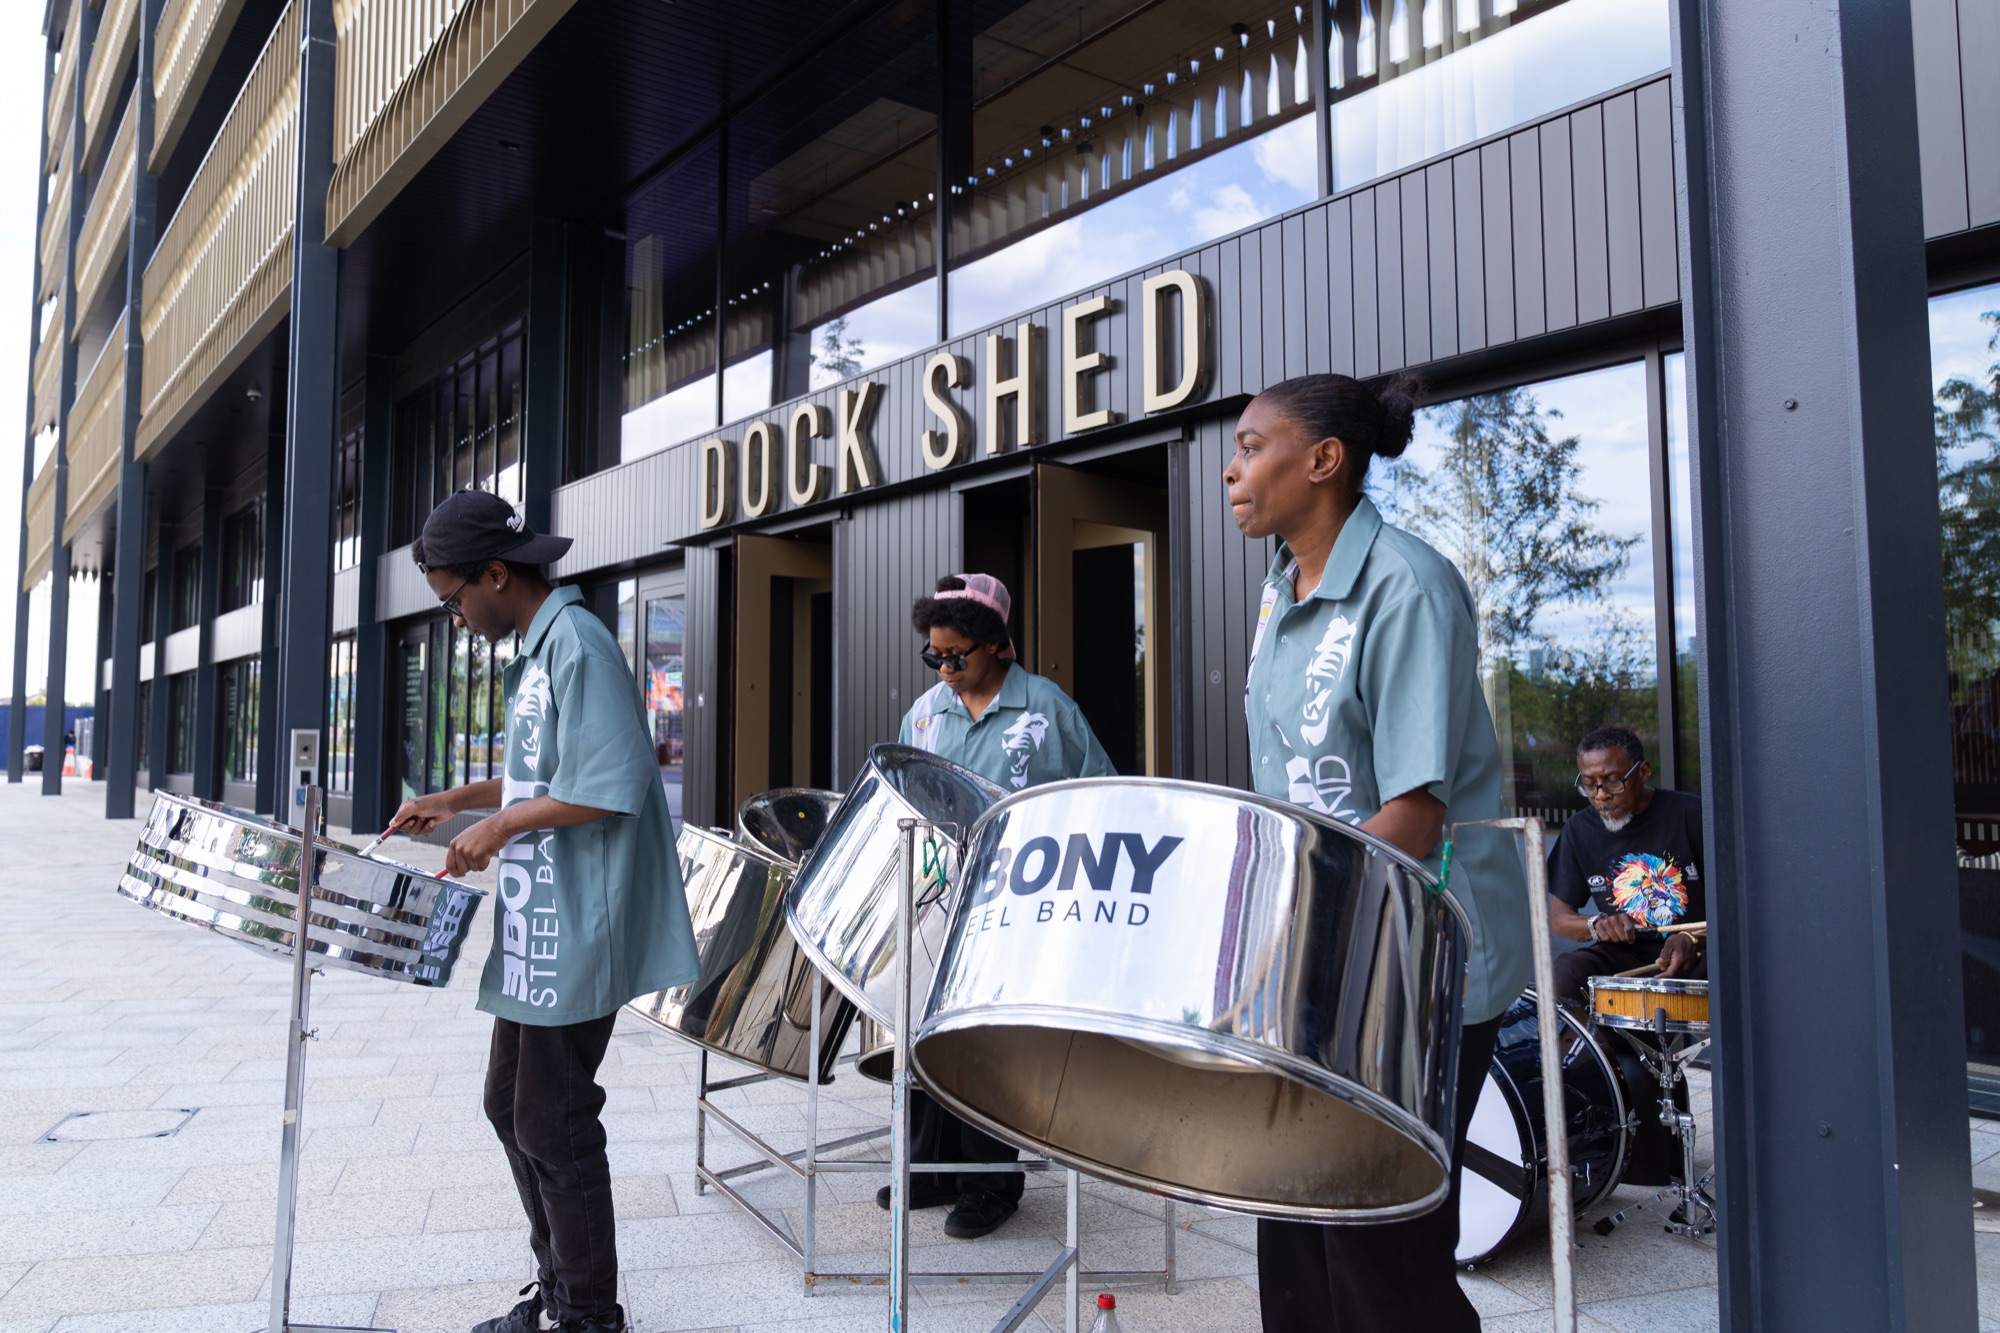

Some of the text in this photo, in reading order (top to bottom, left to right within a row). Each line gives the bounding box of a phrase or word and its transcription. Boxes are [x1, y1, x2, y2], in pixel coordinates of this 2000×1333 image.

[702, 269, 1204, 529] DOCK SHED
[965, 899, 1150, 937] EEL BAND
[972, 832, 1185, 910] BONY
[529, 898, 559, 1009] STEEL
